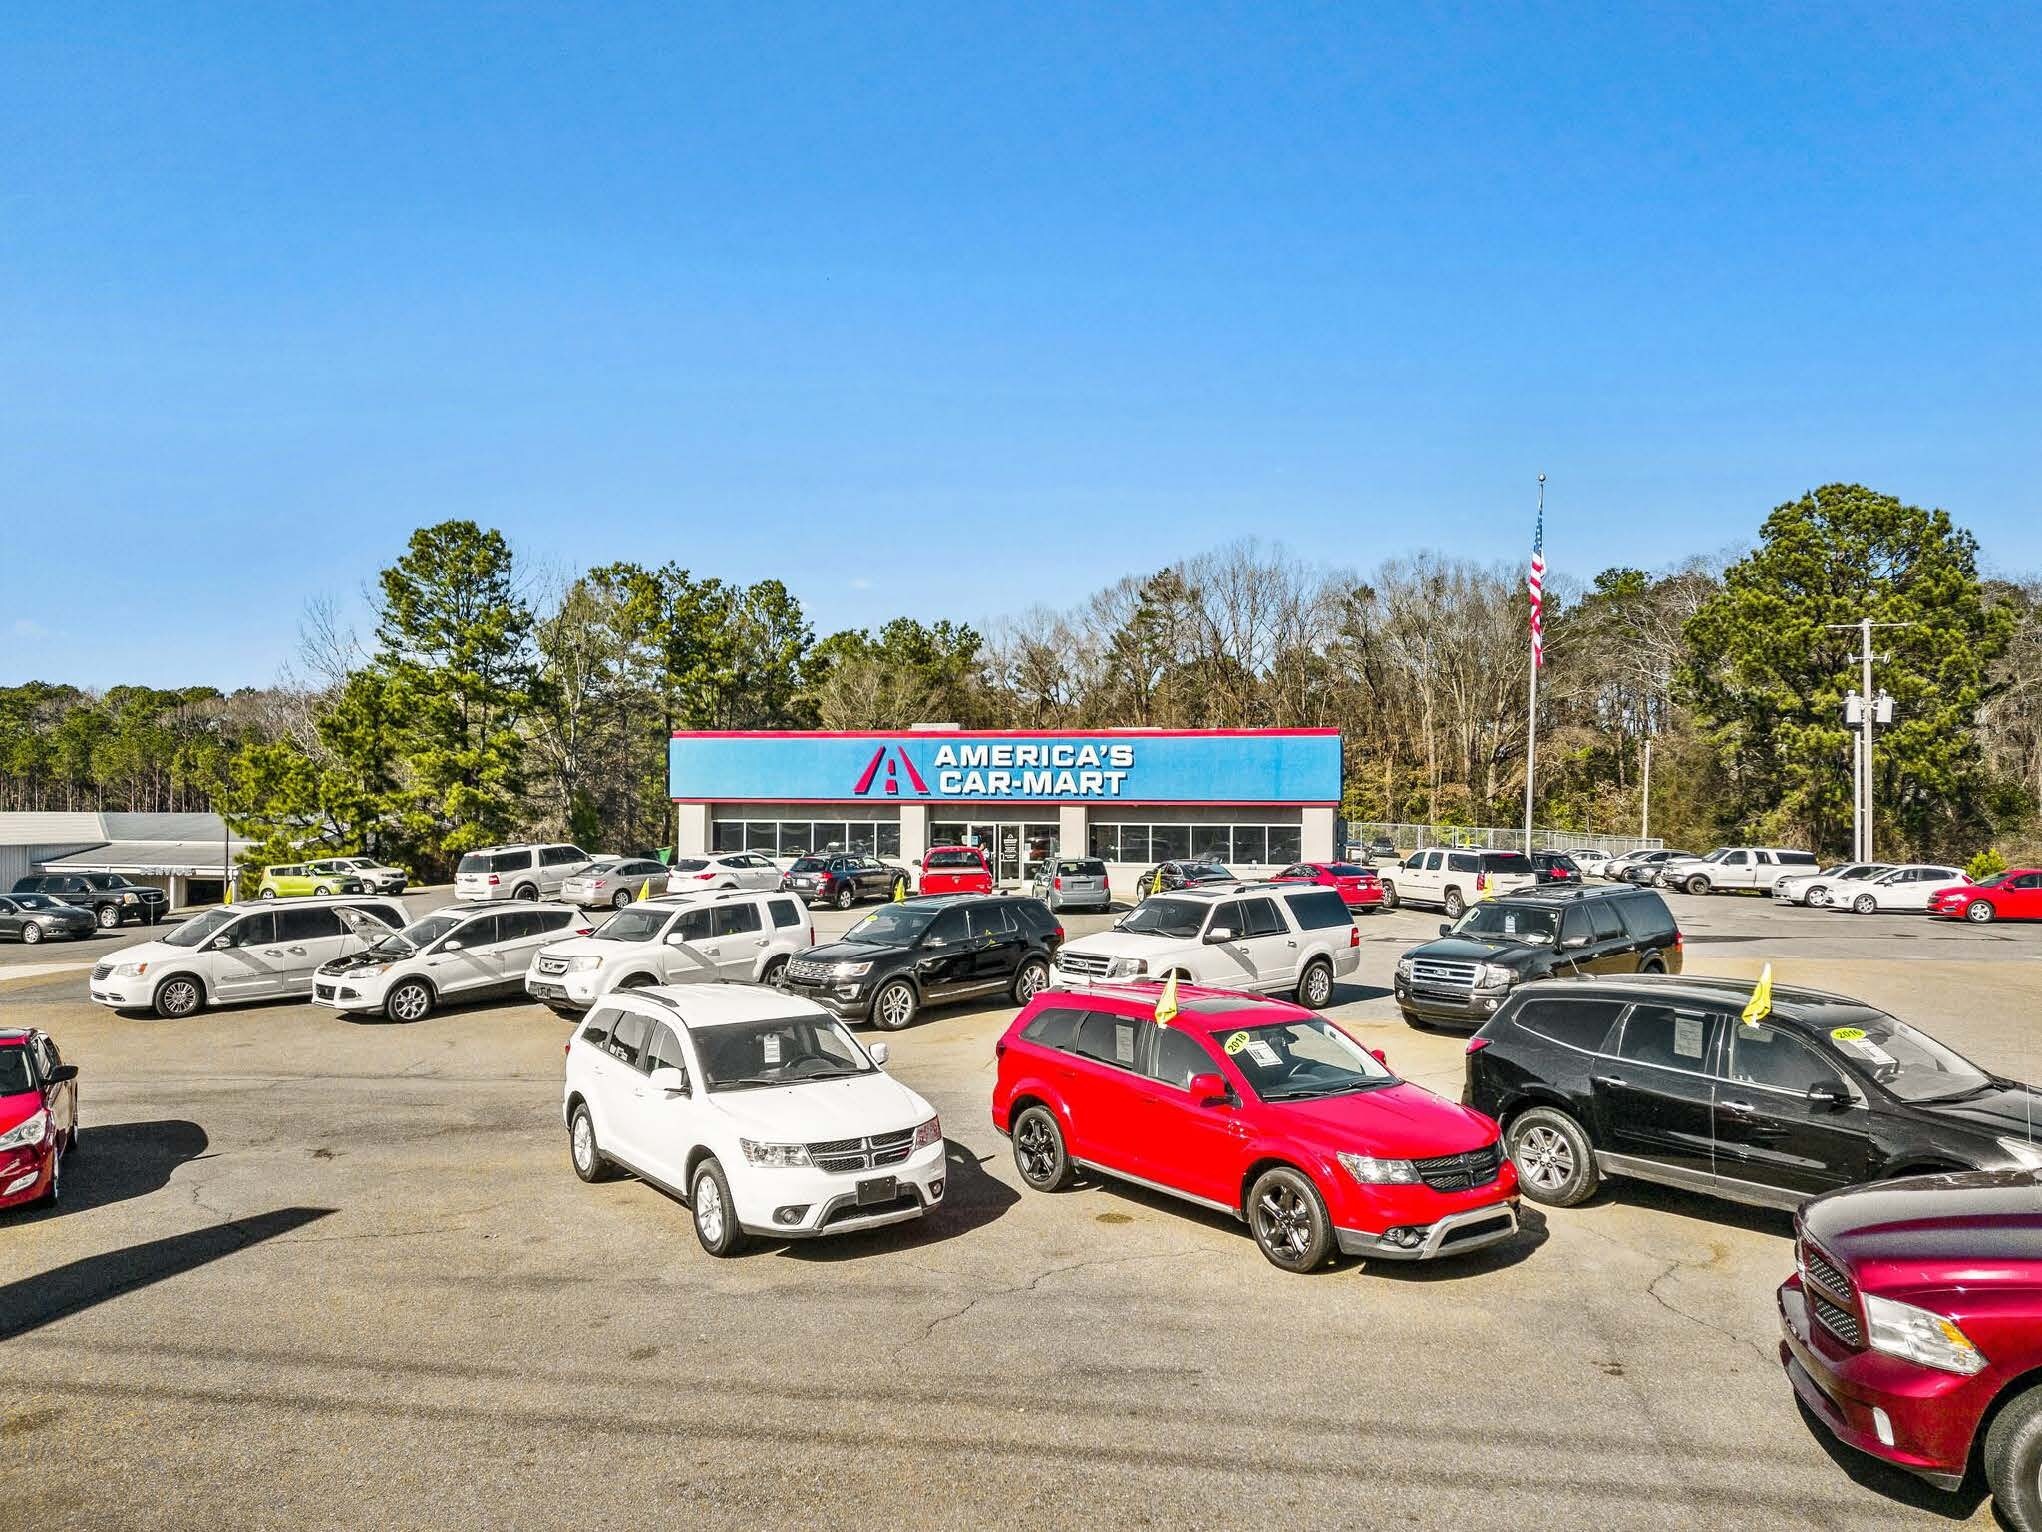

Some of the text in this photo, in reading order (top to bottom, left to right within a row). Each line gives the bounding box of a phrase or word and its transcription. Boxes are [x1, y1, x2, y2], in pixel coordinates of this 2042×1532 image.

[934, 744, 1134, 768] AMERICA'S
[939, 770, 1127, 795] CAR-MART
[139, 866, 193, 877] SERVICE
[1227, 1032, 1247, 1053] 2018
